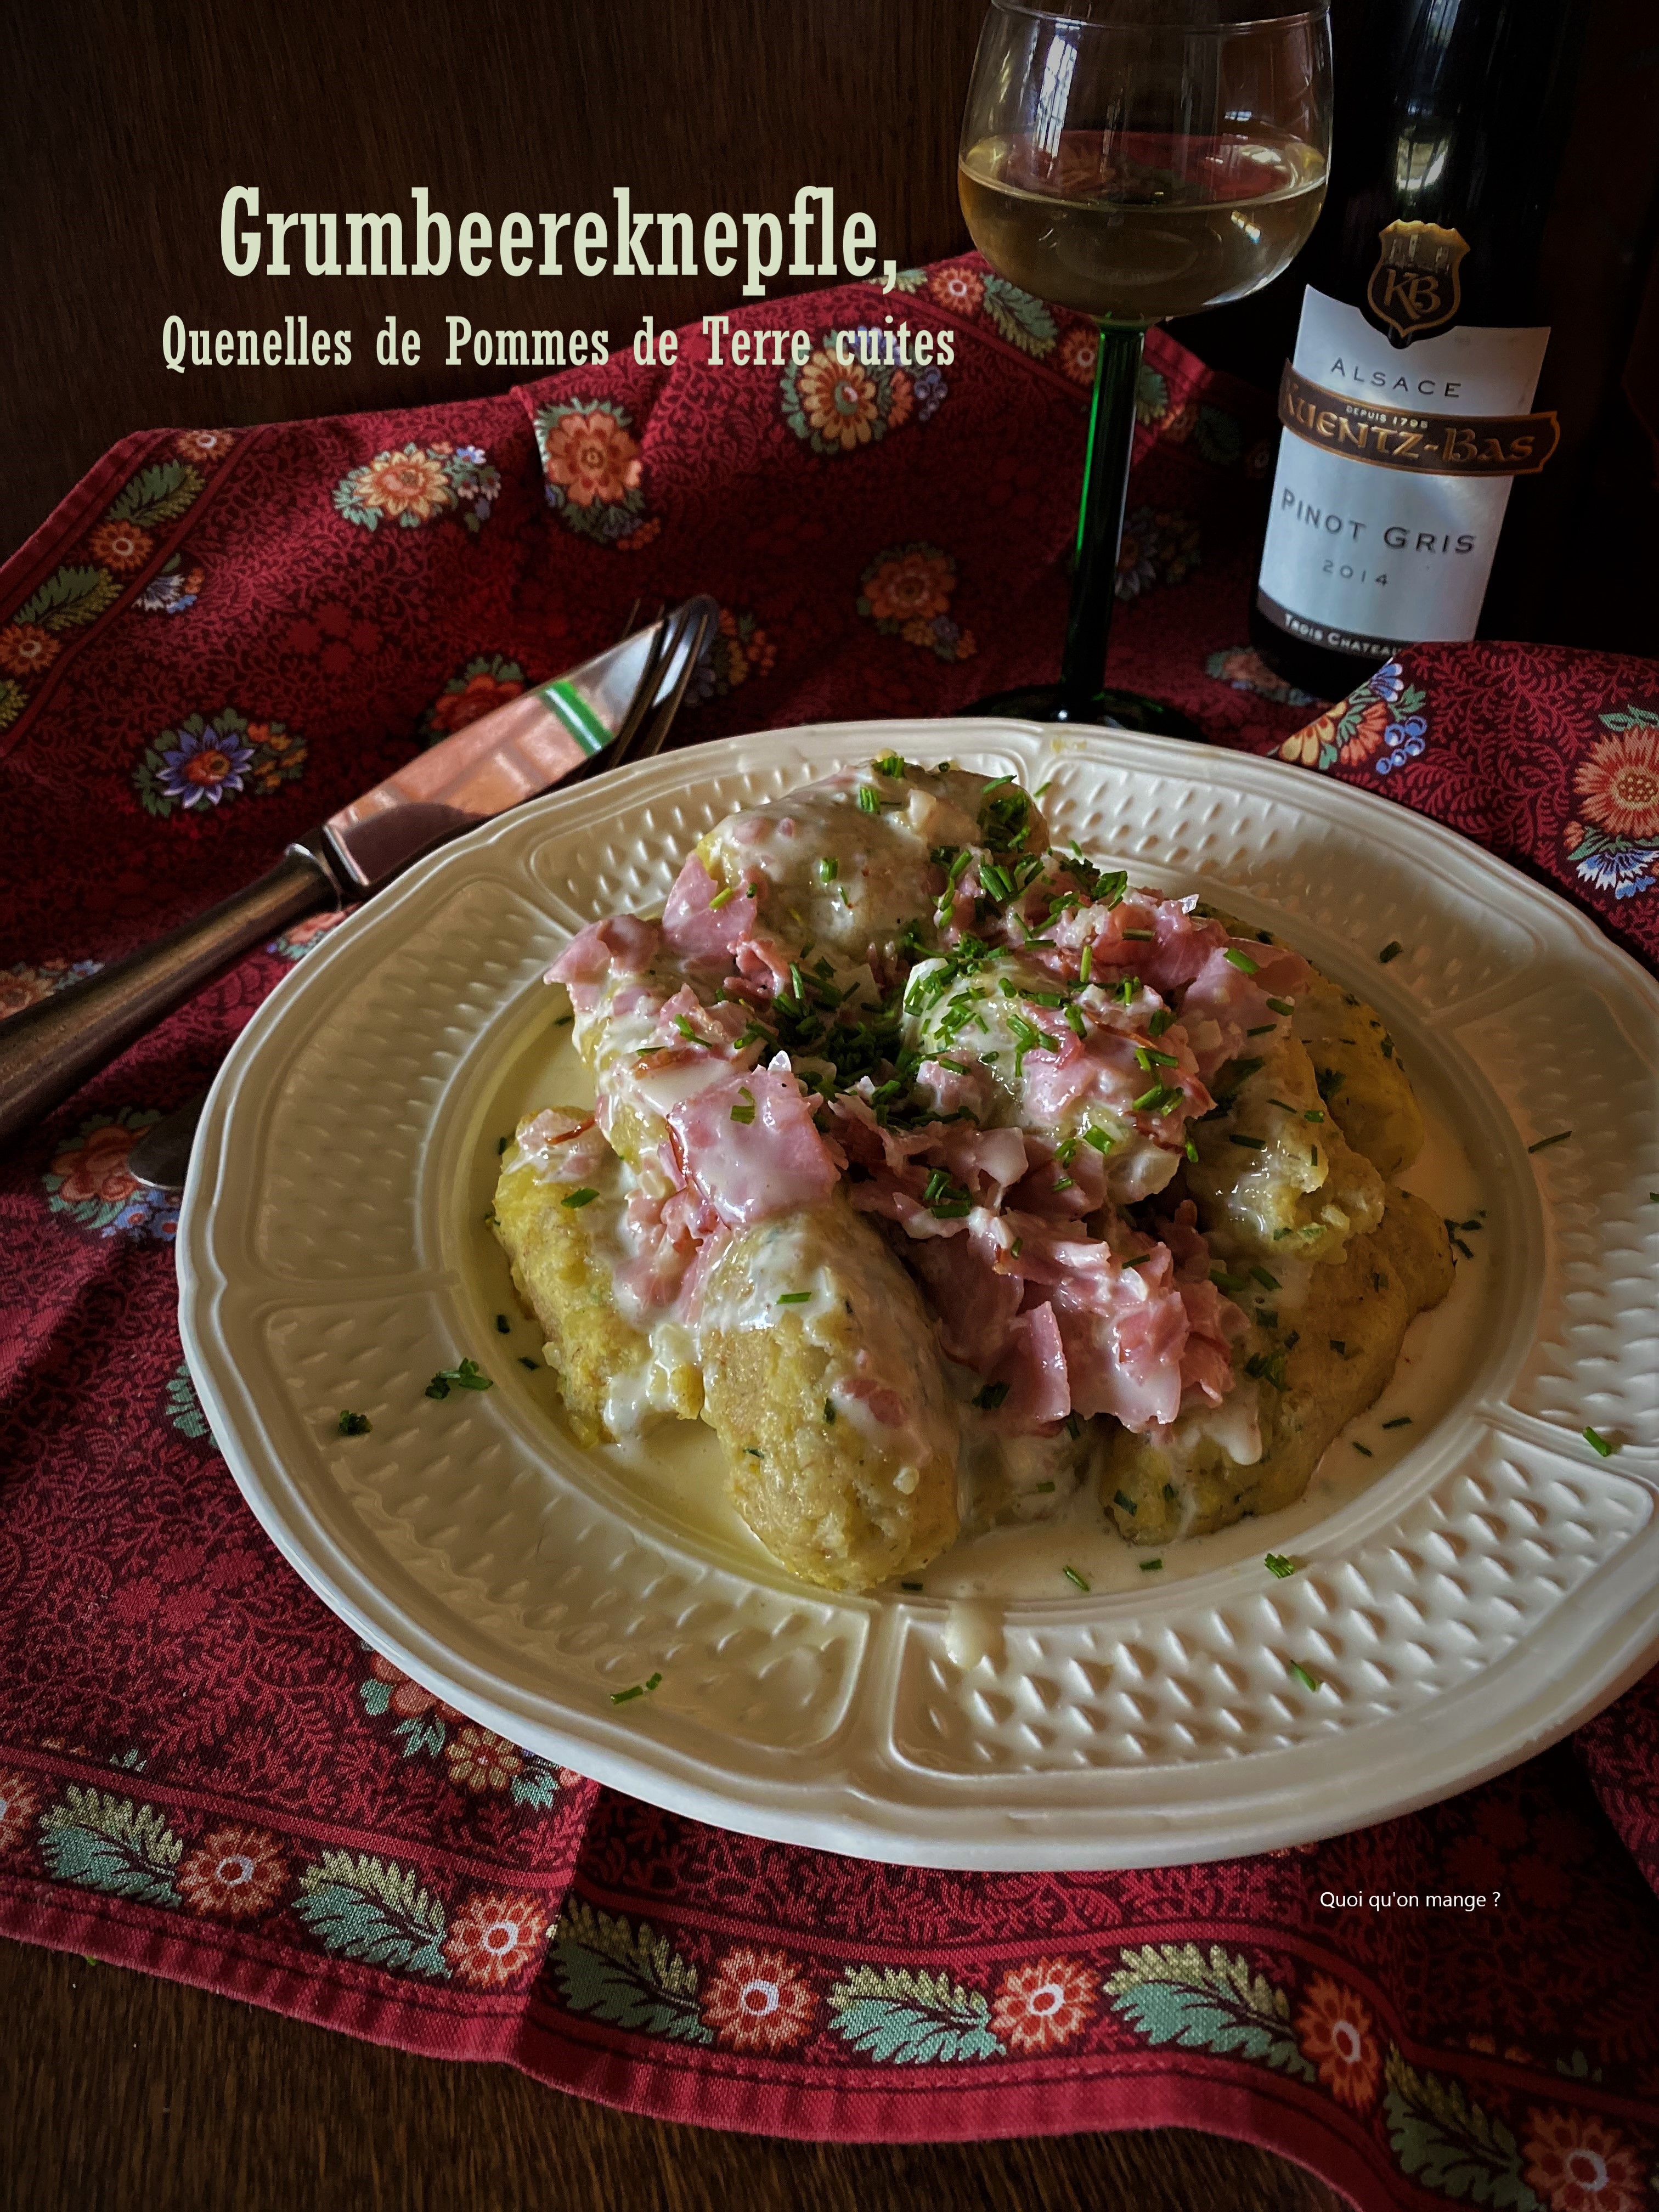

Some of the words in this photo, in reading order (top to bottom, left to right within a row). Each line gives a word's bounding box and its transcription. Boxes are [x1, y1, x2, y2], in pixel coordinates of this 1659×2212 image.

[1384, 268, 1441, 320] KB
[1330, 357, 1462, 398] ALSACE
[1282, 487, 1367, 542] PINOT
[1384, 526, 1476, 553] GRIS
[1323, 559, 1388, 586] 2014
